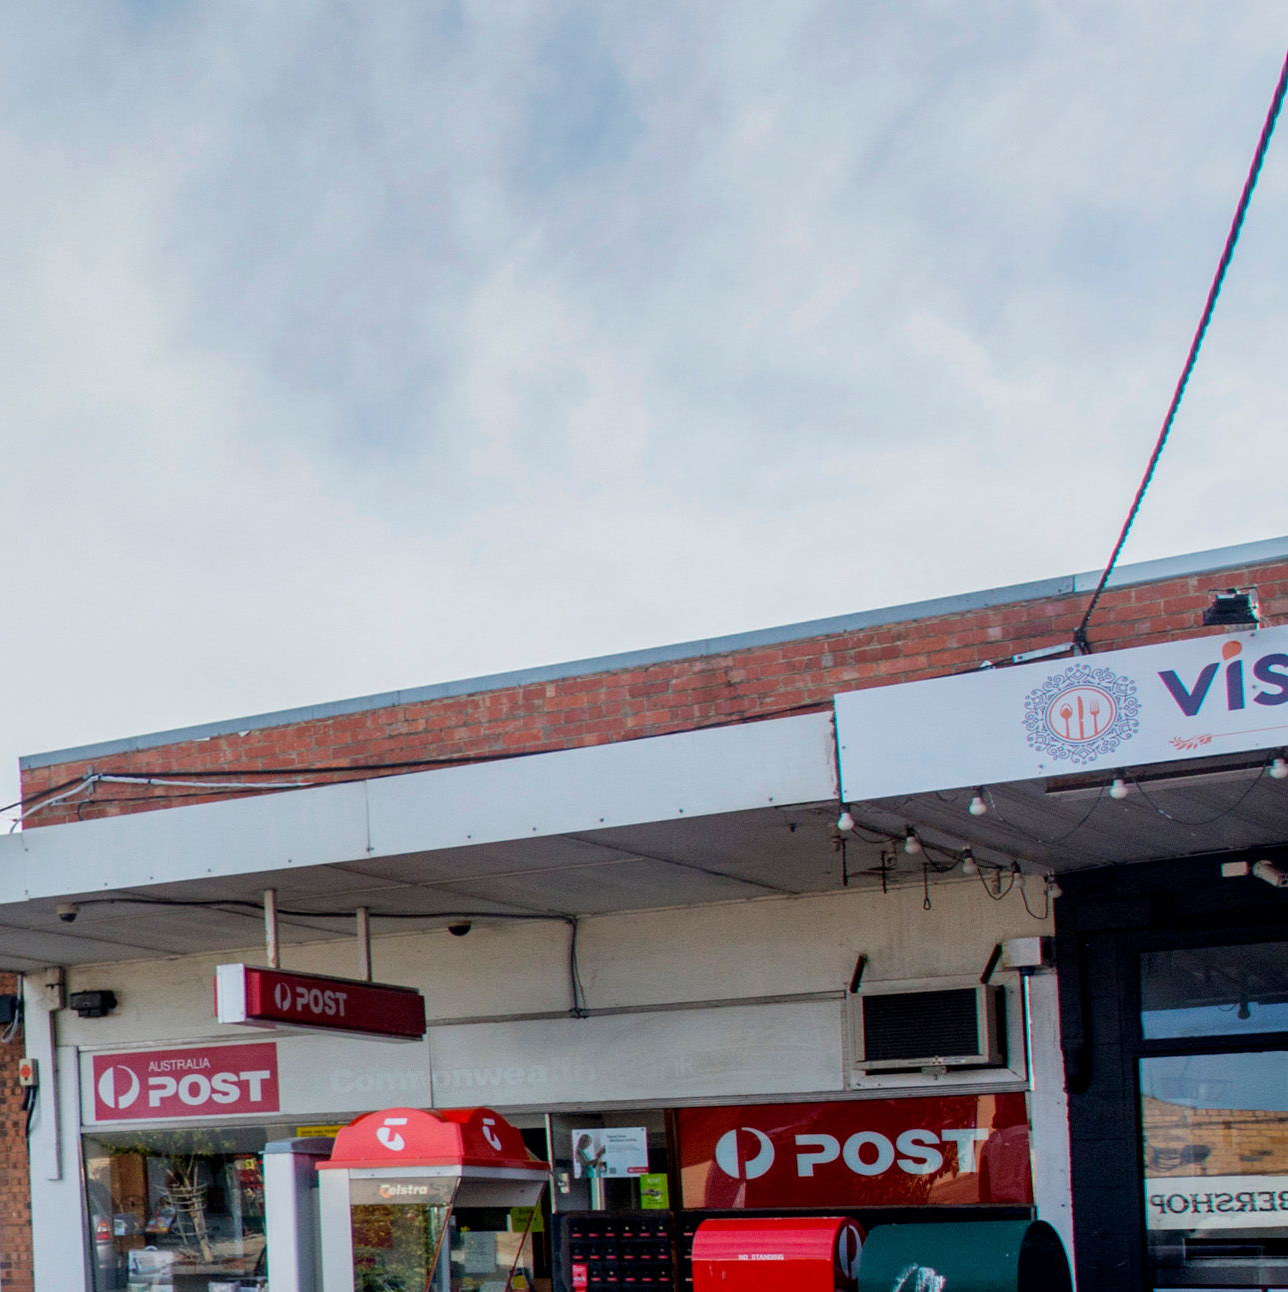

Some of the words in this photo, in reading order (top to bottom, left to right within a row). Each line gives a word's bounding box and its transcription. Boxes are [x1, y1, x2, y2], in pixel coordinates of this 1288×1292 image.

[296, 987, 348, 1017] POST
[148, 1057, 211, 1071] AUSTRALIA
[149, 1070, 271, 1107] POST
[795, 1128, 989, 1177] POST
[379, 1184, 428, 1200] Telstra
[738, 1253, 748, 1261] NO
[751, 1253, 784, 1261] STANDING
